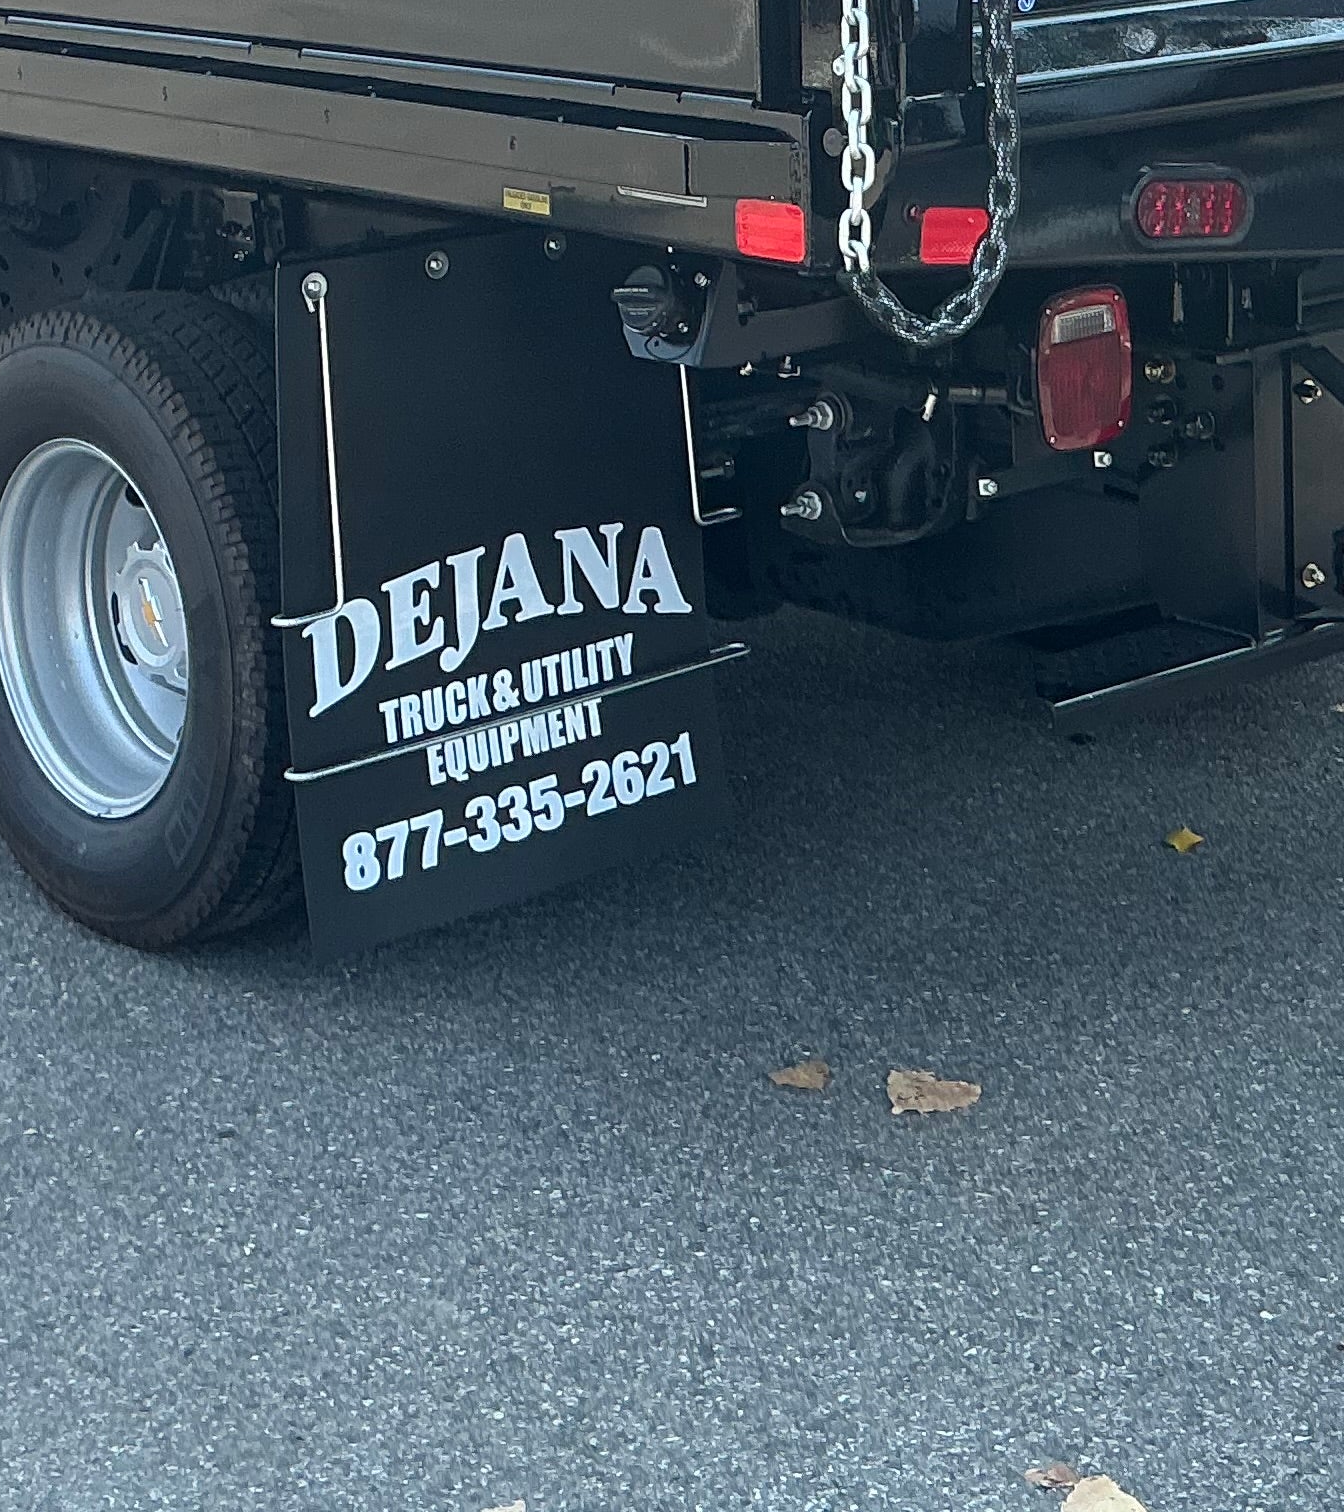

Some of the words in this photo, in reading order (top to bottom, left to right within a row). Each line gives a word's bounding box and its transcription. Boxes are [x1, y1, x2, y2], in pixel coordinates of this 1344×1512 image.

[301, 522, 693, 719] DEJANA
[379, 674, 492, 744] TRUCK
[492, 669, 520, 713] &
[521, 632, 635, 704] UTILITY
[426, 698, 605, 786] EQUIPMENT
[342, 732, 698, 892] 877-335-2621
